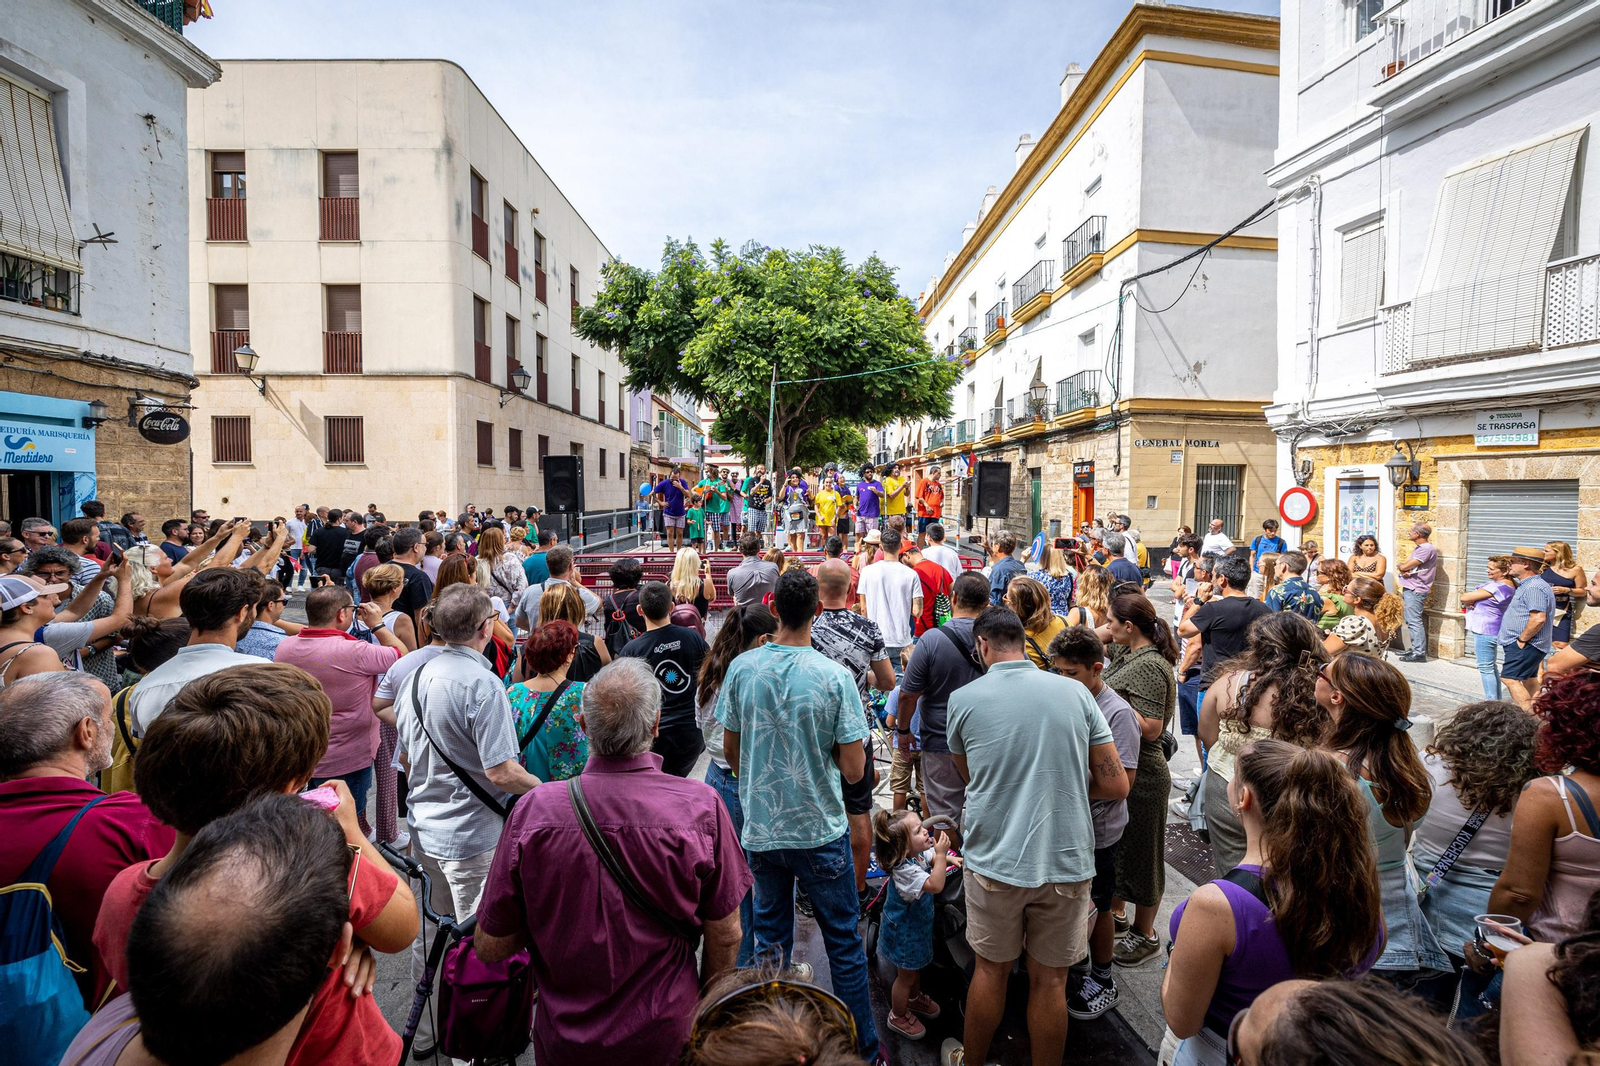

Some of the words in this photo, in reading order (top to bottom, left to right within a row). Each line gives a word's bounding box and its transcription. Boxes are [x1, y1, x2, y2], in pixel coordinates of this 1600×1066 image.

[142, 416, 181, 431] Coca-Cola
[1477, 423, 1487, 431] SE
[1489, 421, 1536, 430] TRASPASA
[0, 426, 37, 436] EIDURÍA
[38, 429, 91, 440] MARISQUERÍA
[1476, 433, 1536, 443] 667596981
[1134, 439, 1182, 448] GENERAL
[1185, 439, 1220, 448] MORLA
[4, 451, 54, 464] Mentidero
